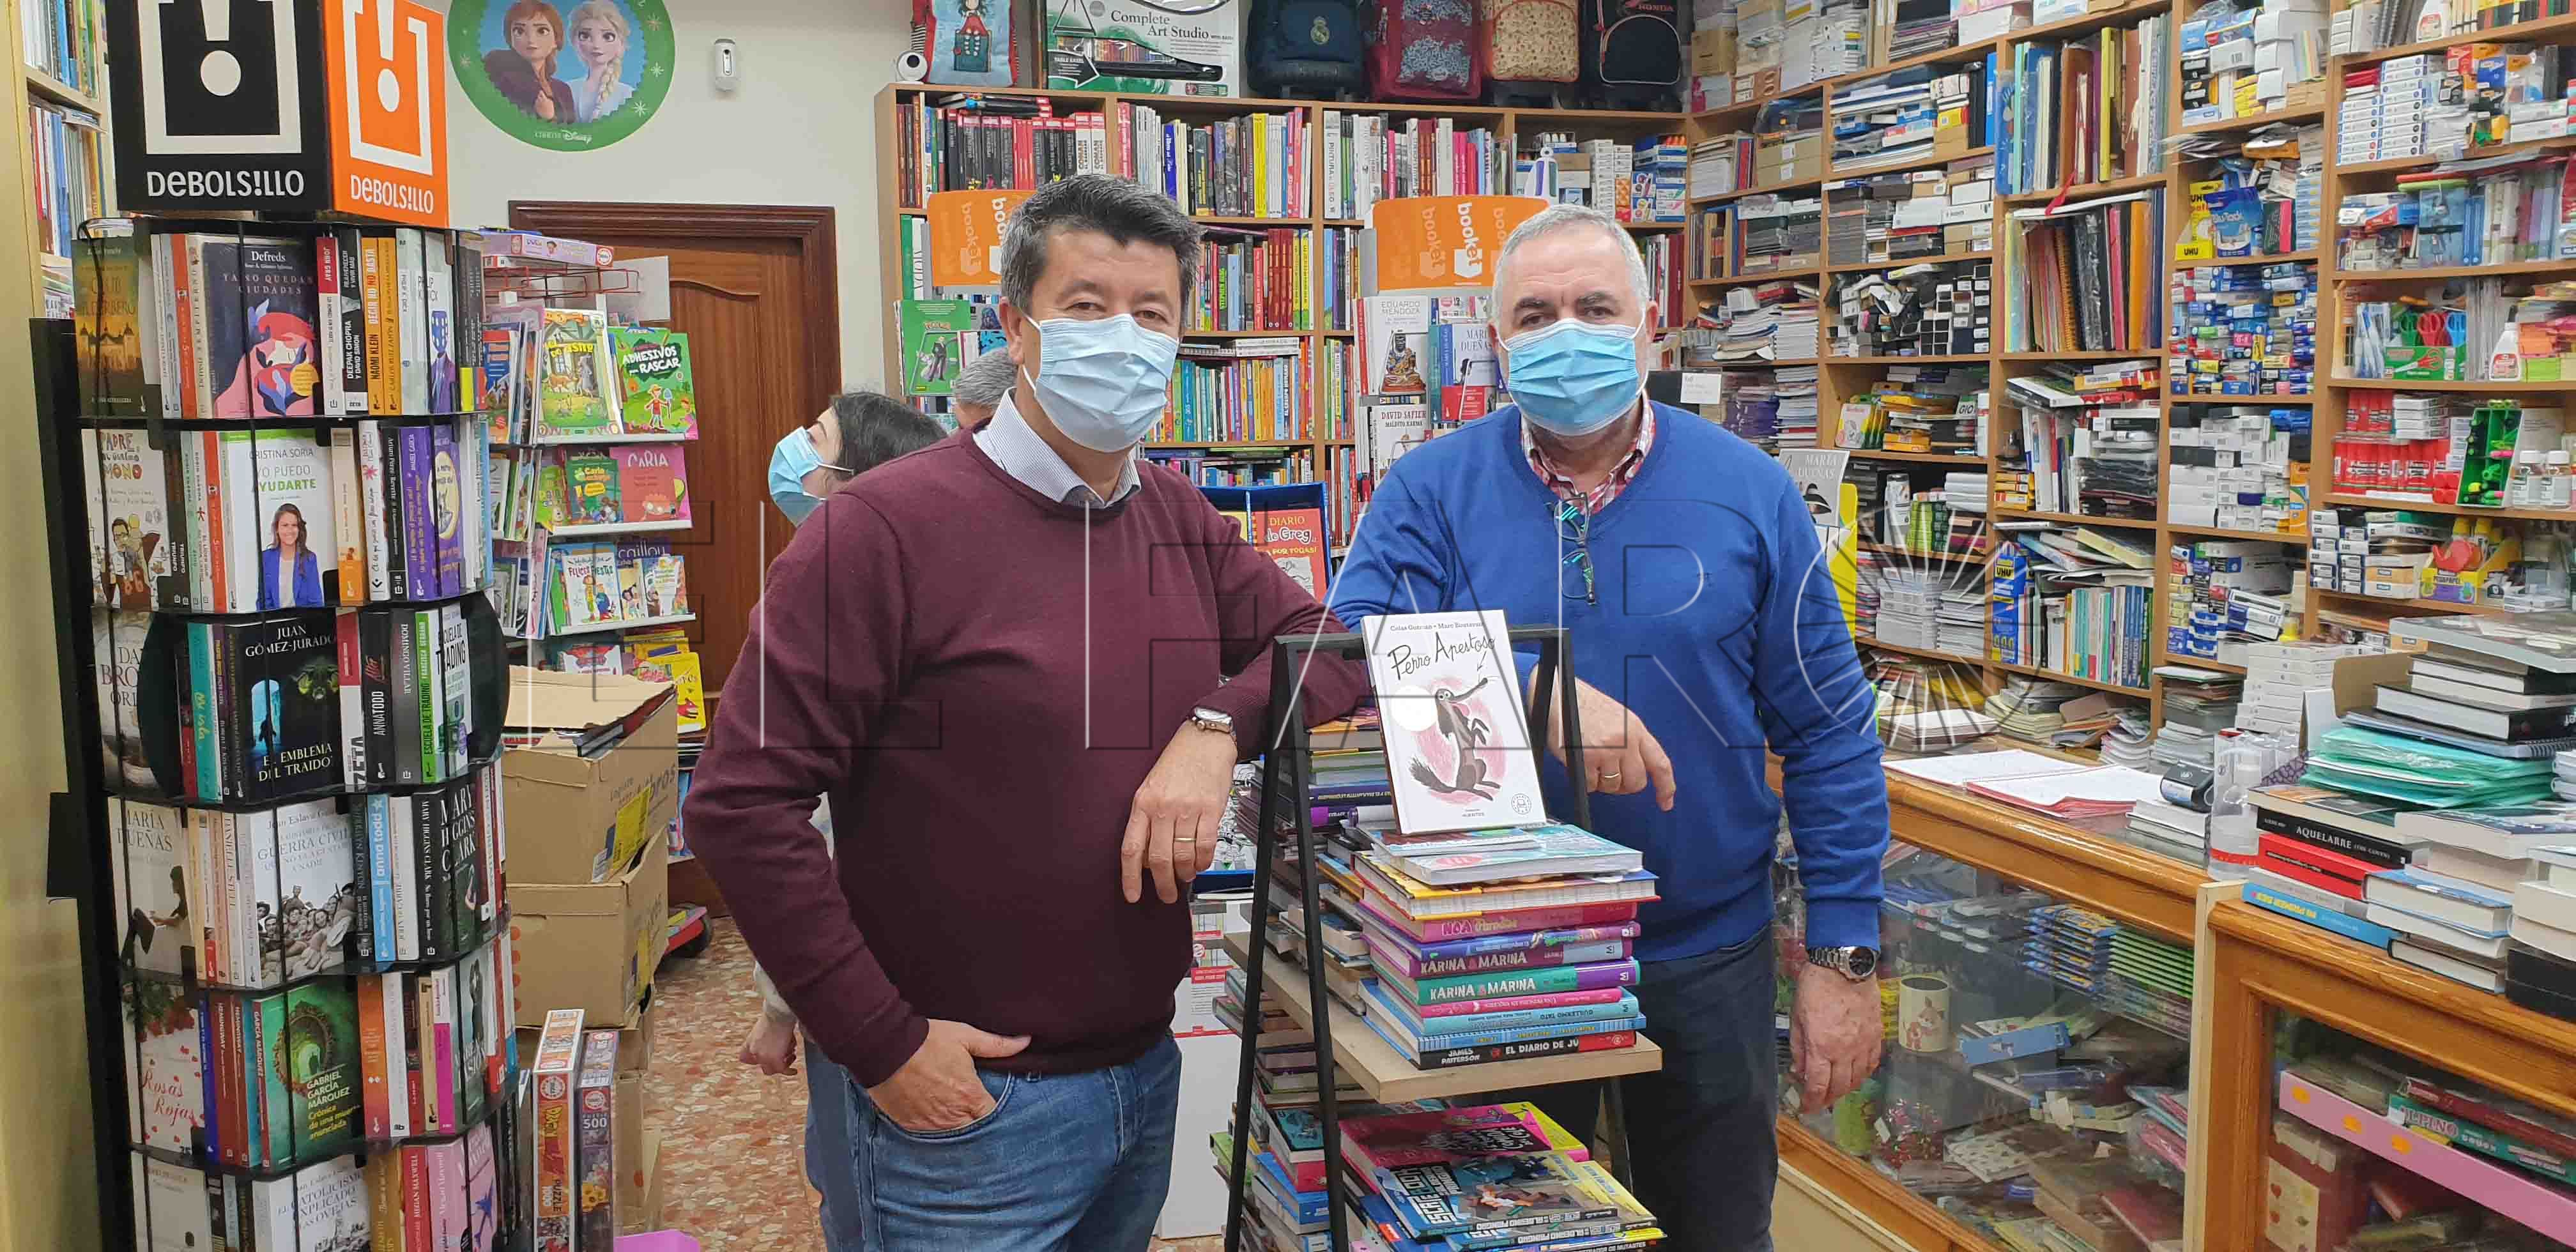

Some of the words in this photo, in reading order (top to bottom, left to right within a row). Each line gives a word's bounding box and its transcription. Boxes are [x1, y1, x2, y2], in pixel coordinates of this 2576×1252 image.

[1110, 10, 1170, 31] Complete
[1148, 24, 1167, 37] Art
[1170, 26, 1209, 40] Studio
[1457, 202, 1483, 266] booket
[1492, 206, 1508, 246] boo
[251, 250, 286, 263] Defreds
[370, 334, 379, 355] KLEIN
[622, 346, 677, 365] ADHESIVOS
[371, 356, 379, 379] NAOMI
[639, 359, 681, 374] RASCAR
[1381, 411, 1402, 420] DAVID
[273, 464, 310, 477] PUEDO
[1269, 515, 1305, 526] DIARIO
[1280, 526, 1312, 545] Greg
[1996, 567, 2012, 576] UHU
[277, 623, 307, 639] JUAN
[401, 623, 409, 656] DOMINGO
[436, 641, 466, 675] TADING
[1388, 644, 1432, 680] Perro
[1435, 632, 1496, 663] Apestoso
[422, 683, 431, 714] TRADING
[280, 743, 332, 765] EMBLEMA
[374, 813, 384, 843] todd
[2296, 825, 2352, 850] AQUELARRE
[376, 844, 386, 876] anna
[1420, 958, 1466, 973] KARINA
[1478, 952, 1528, 968] MARINA
[1430, 983, 1475, 1001] KARINA
[1487, 977, 1536, 995] MARINA
[1448, 1048, 1473, 1058] JAMES
[1505, 1046, 1515, 1055] EL
[1519, 1042, 1552, 1054] DIARIO
[1553, 1040, 1567, 1051] DE
[1441, 1053, 1480, 1065] PATTERSON
[142, 1071, 184, 1097] Rosas
[307, 1072, 342, 1090] GABRIEL
[307, 1081, 339, 1099] GARCÍA
[308, 1087, 351, 1110] MÁRQUEZ
[582, 1117, 607, 1129] 500
